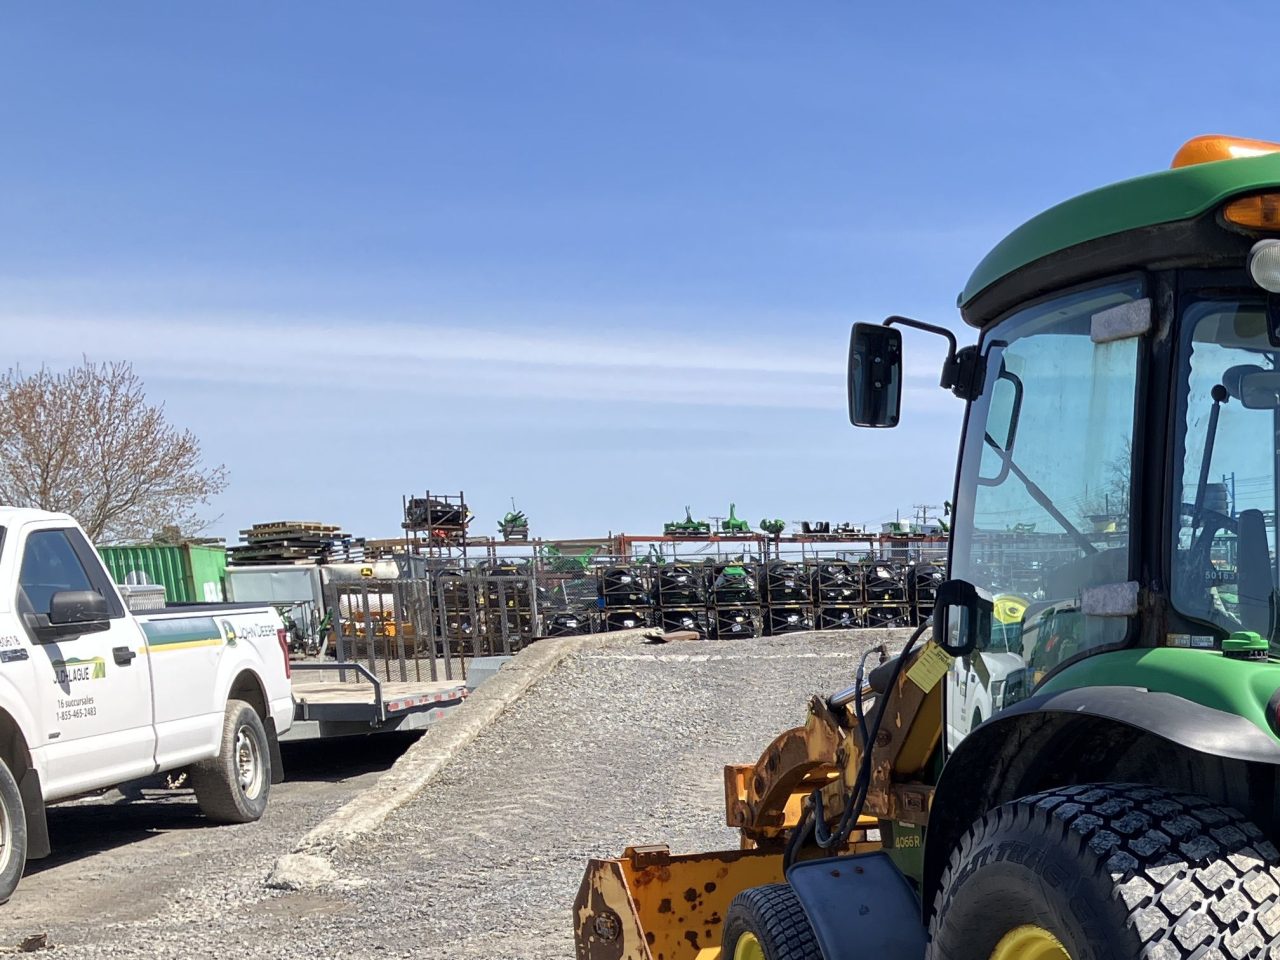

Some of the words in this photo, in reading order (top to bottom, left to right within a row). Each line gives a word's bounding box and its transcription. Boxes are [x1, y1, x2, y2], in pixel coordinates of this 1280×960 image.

[57, 699, 65, 709] 16
[65, 695, 95, 707] succursales
[56, 706, 97, 722] 1-855-465-2483
